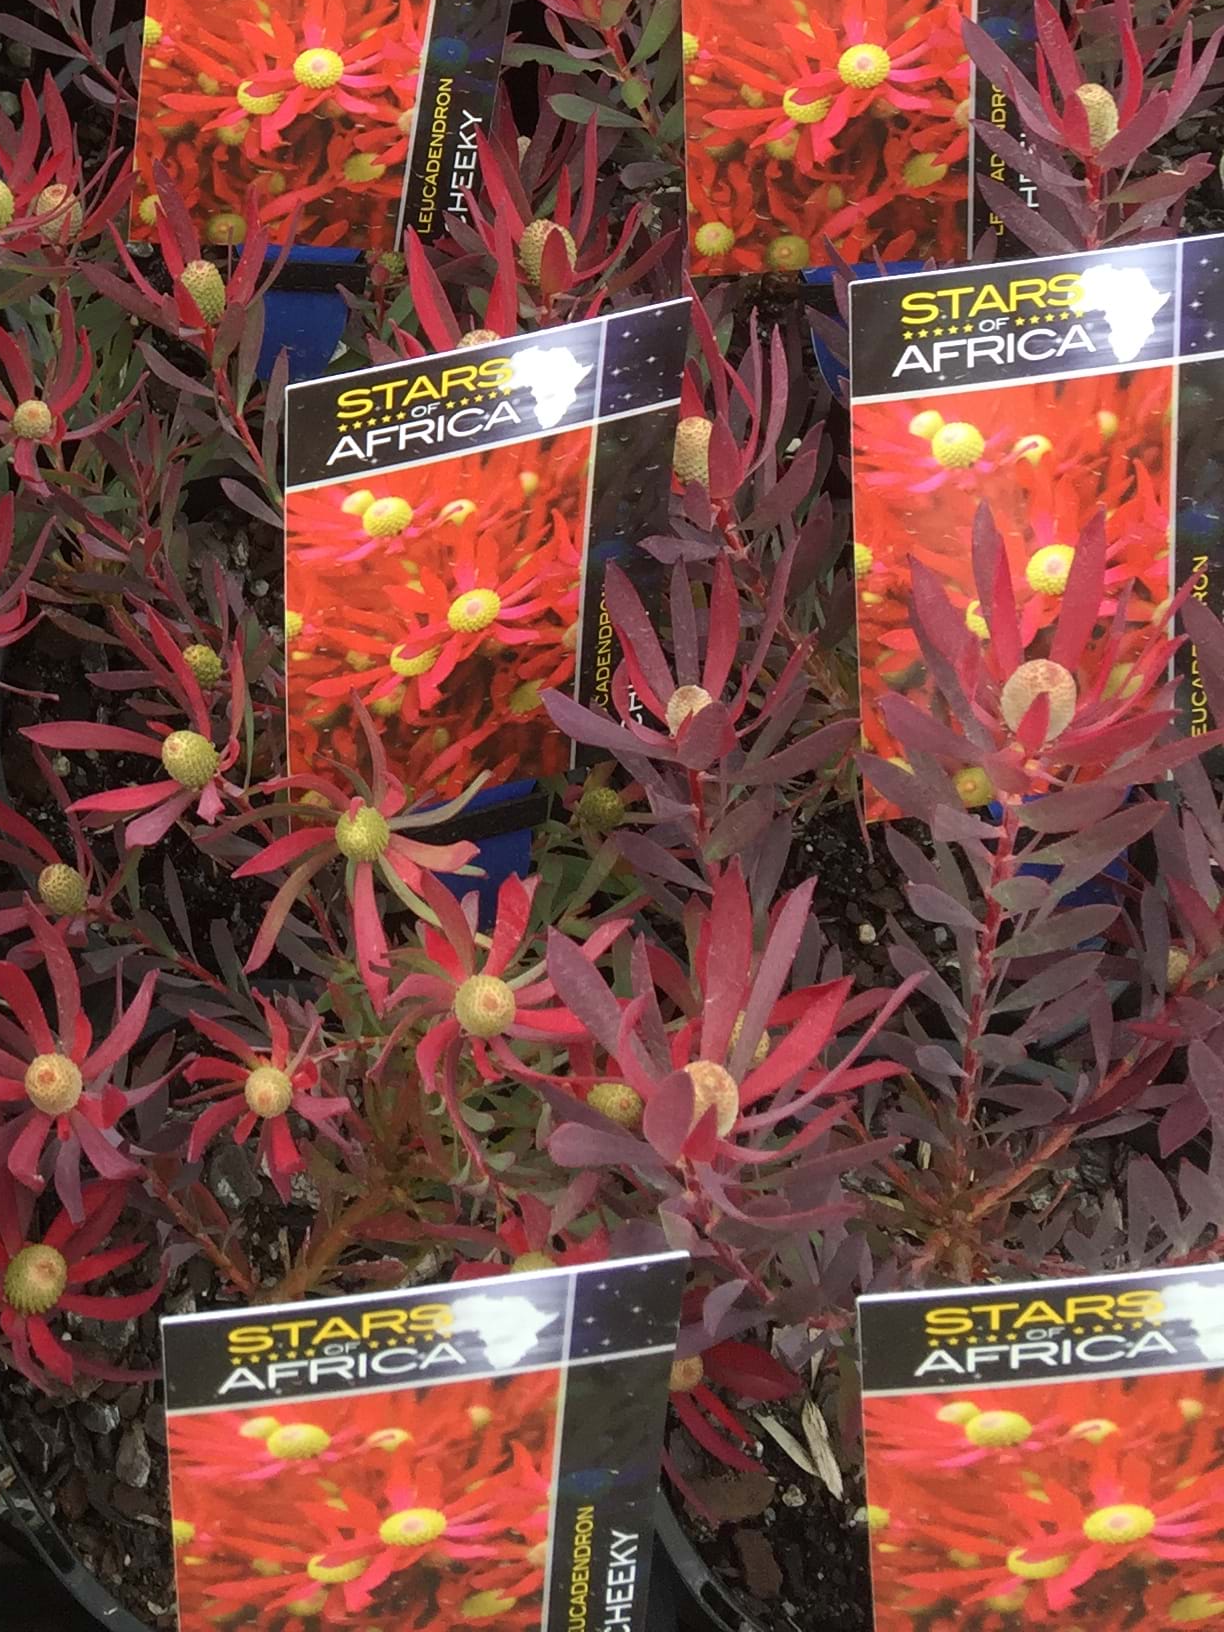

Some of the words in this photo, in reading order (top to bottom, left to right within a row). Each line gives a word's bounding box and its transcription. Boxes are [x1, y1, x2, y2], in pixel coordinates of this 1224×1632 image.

[417, 77, 453, 234] LEUCADENDRON
[900, 274, 1083, 326] STARS
[979, 317, 1009, 332] OF
[892, 325, 1096, 377] AFRICA
[336, 358, 512, 419] STARS
[411, 402, 440, 417] OF
[327, 402, 519, 466] AFRICA
[228, 1304, 454, 1355] STARS
[925, 1290, 1165, 1337] STARS
[1026, 1327, 1064, 1340] OF
[218, 1343, 466, 1396] AFRICA
[324, 1342, 360, 1355] OF
[915, 1332, 1176, 1377] AFRICA
[569, 1506, 595, 1632] UCADENDRON
